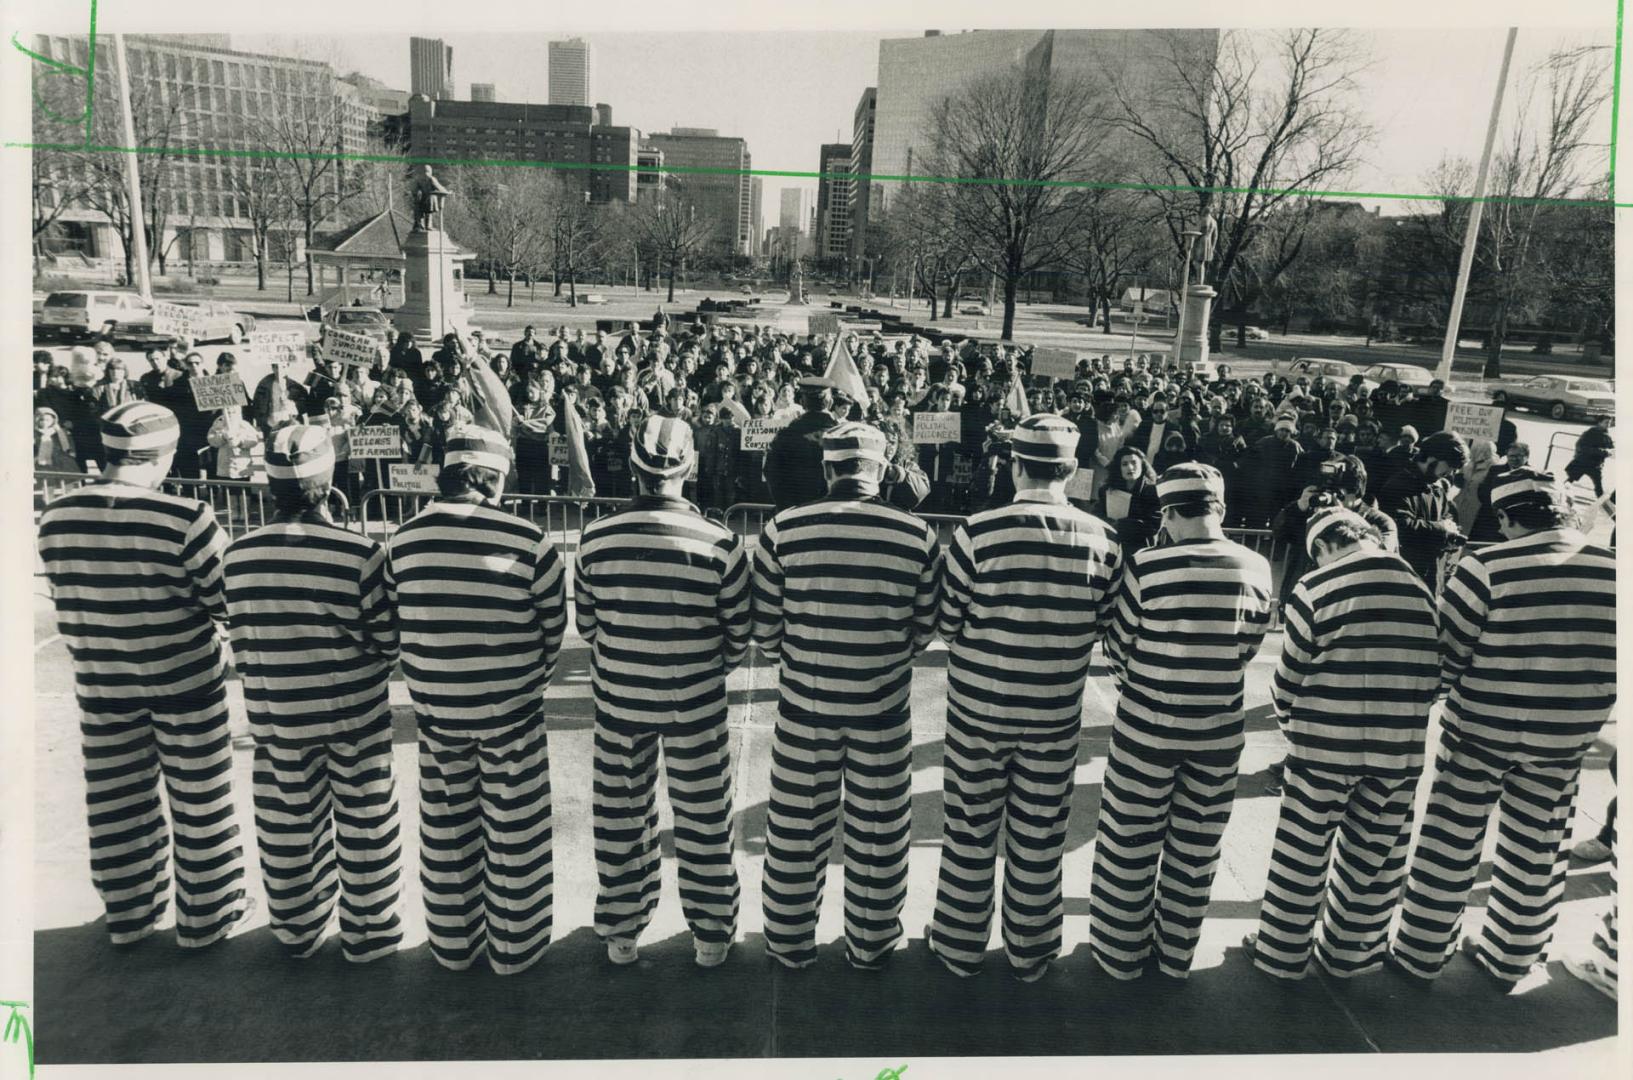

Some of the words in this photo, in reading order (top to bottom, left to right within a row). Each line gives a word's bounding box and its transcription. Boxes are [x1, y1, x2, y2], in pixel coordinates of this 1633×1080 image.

[232, 384, 243, 393] TO
[1450, 405, 1472, 415] FREE
[743, 420, 763, 428] FREE
